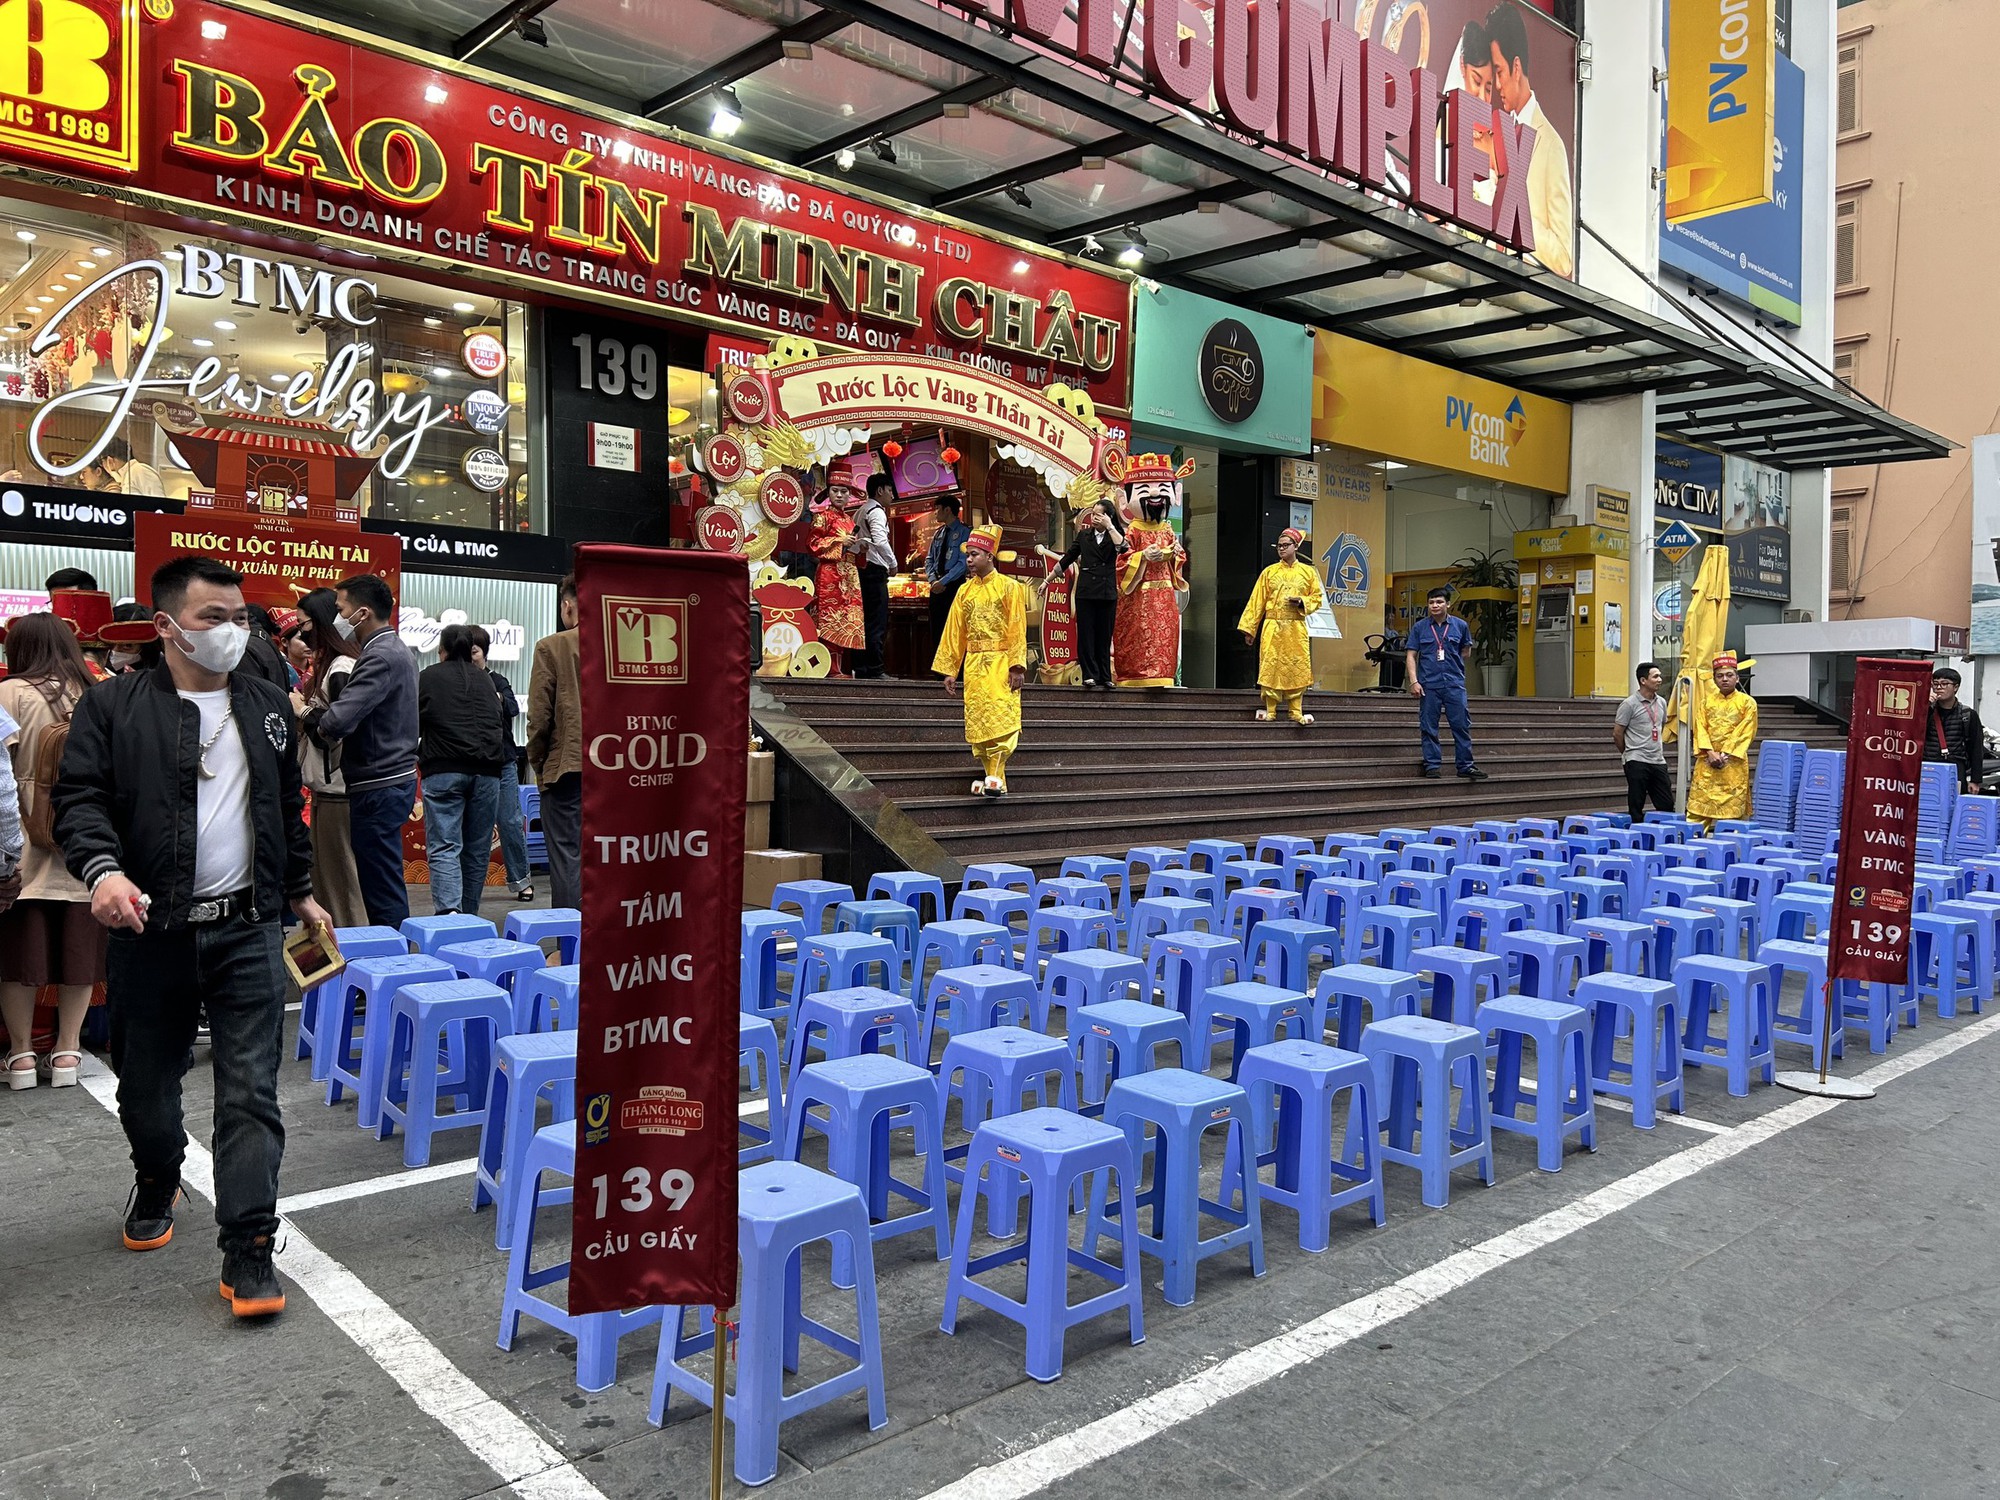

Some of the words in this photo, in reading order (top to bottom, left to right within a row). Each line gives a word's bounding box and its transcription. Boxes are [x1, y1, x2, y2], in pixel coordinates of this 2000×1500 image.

[45, 111, 110, 143] 1989
[489, 105, 568, 145] CÔNG
[581, 131, 611, 159] TY
[808, 200, 835, 224] ĐÁ
[934, 236, 971, 263] LTD)
[171, 59, 447, 204] BẢO
[472, 143, 669, 264] TÍN
[681, 201, 924, 327] MINH
[934, 277, 1120, 372] CHÂU
[177, 242, 377, 327] BTMC
[216, 174, 301, 216] KINH
[317, 199, 423, 243] DOANH
[435, 228, 490, 260] CHẾ
[502, 241, 551, 272] TÁC
[563, 256, 646, 294] TRANG
[656, 279, 701, 306] SỨC
[717, 292, 770, 322] VÀNG
[778, 307, 816, 333] BẠC
[836, 321, 859, 343] ĐÁ
[865, 328, 901, 351] QUÝ
[925, 344, 953, 361] KIM
[959, 351, 1012, 377] CƯƠNG
[1026, 366, 1047, 384] MỸ
[474, 358, 496, 368] GOLD
[475, 350, 496, 360] TRUE
[719, 347, 758, 367] TRU
[25, 259, 452, 480] Jewelry
[572, 333, 657, 400] 139
[468, 402, 502, 415] UNIQUE
[734, 391, 763, 407] Rước
[816, 376, 876, 407] Rước
[882, 373, 919, 402] Lộc
[926, 377, 978, 414] Vàng
[984, 390, 1030, 431] Thần
[1036, 415, 1065, 450] Tài
[1446, 395, 1505, 441] PVcom
[712, 448, 738, 469] Lộc
[1470, 435, 1510, 468] Bank
[1325, 473, 1335, 487] 10
[1338, 476, 1371, 493] YEARS
[32, 502, 127, 525] THƯƠNG
[705, 522, 738, 546] Vàng
[1607, 537, 1624, 551] ATM
[1663, 534, 1687, 543] ATM
[170, 530, 231, 552] RƯỚC
[236, 536, 276, 558] LỘC
[281, 539, 334, 561] THẦN
[340, 544, 370, 563] TÀI
[413, 534, 450, 553] CỦA
[454, 541, 499, 557] BTMC
[240, 559, 278, 576] XUÂN
[282, 563, 304, 580] ĐẠI
[308, 564, 342, 580] PHÁT
[772, 627, 794, 644] 20
[1050, 630, 1068, 641] LONG
[1948, 630, 1960, 645] ATM
[1049, 647, 1070, 658] 999.9
[618, 663, 649, 675] BTMC
[653, 664, 678, 675] 1989
[626, 715, 677, 731] BTMC
[1884, 728, 1906, 738] BTMC
[588, 733, 707, 771] GOLD
[1865, 735, 1918, 755] GOLD
[628, 773, 673, 787] CENTER
[1863, 777, 1914, 795] TRUNG
[1873, 803, 1904, 820] TÂM
[594, 829, 708, 864] TRUNG
[1863, 829, 1906, 848] VÀNG
[1861, 856, 1905, 875] BTMC
[621, 891, 682, 927] TÂM
[1850, 919, 1902, 945] 139
[1845, 944, 1870, 957] CẦU
[1874, 950, 1902, 963] GIẤY
[606, 952, 693, 991] VÀNG
[602, 1016, 693, 1054] BTMC
[642, 1089, 663, 1097] VÀNG
[623, 1103, 667, 1118] THĂNG
[670, 1106, 701, 1118] LONG
[590, 1165, 694, 1220] 139
[585, 1230, 629, 1262] CẦU
[640, 1224, 698, 1252] GIẤY
